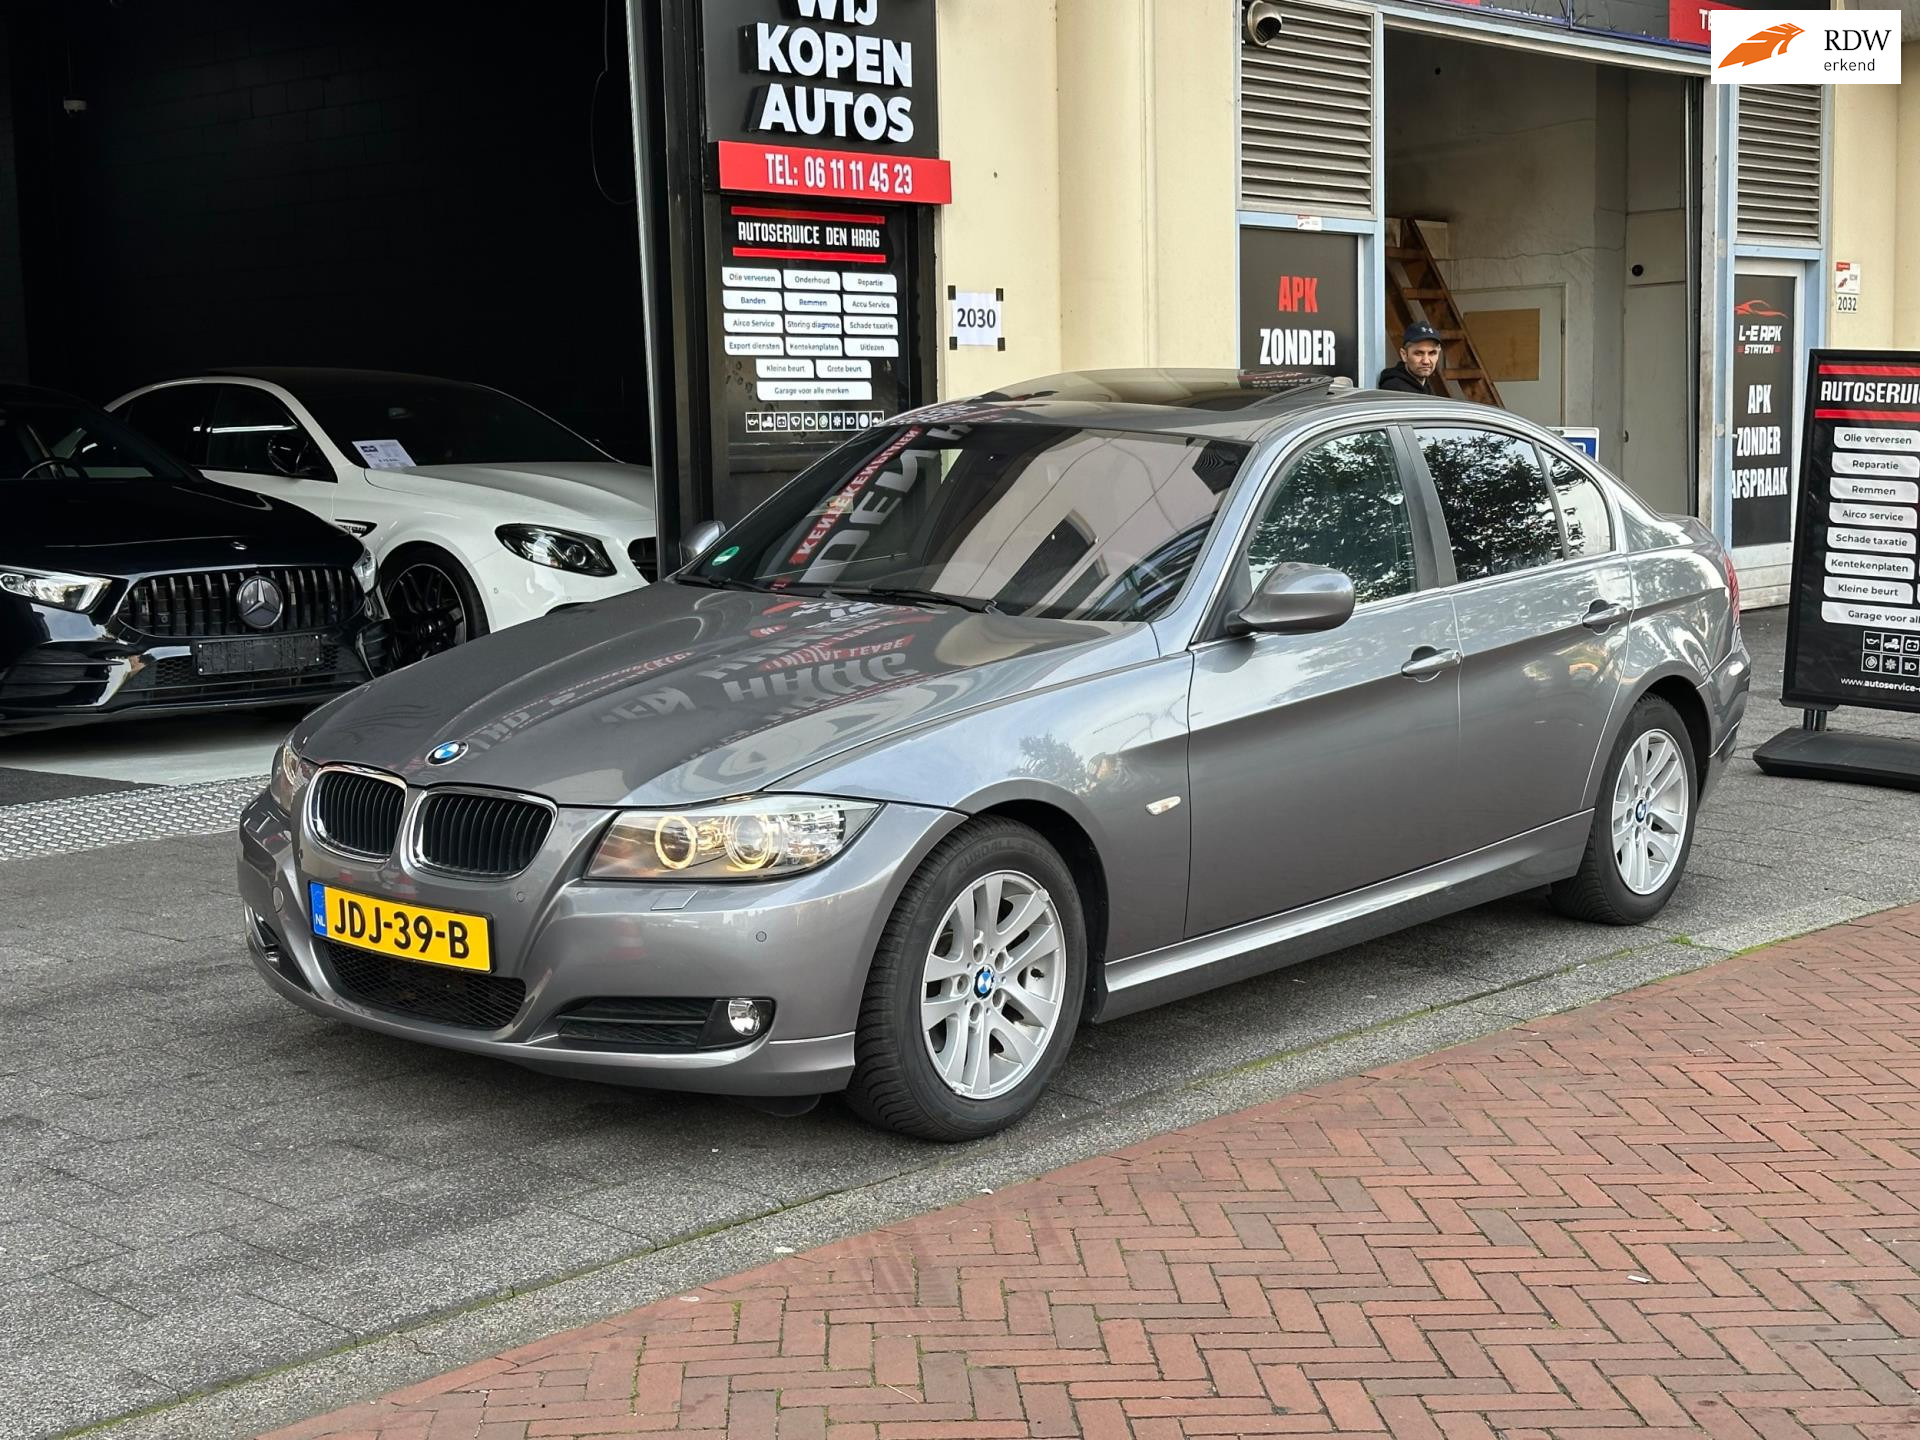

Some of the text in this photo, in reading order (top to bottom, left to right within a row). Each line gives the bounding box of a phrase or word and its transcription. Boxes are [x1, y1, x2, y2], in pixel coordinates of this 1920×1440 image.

[757, 22, 913, 88] KOPEN
[759, 83, 914, 142] AUTOS
[765, 153, 912, 194] TEL: 06 11 11 45 23
[738, 221, 880, 248] AUTOSERVICE DEN HAAG
[794, 276, 830, 284] Onderhoud
[740, 296, 766, 304] Banden
[1278, 276, 1318, 313] APK
[1838, 296, 1857, 311] 2032
[733, 319, 775, 327] Airco Service
[957, 308, 996, 328] 2030
[787, 320, 840, 330] Storing diagnose
[1738, 324, 1782, 342] L-E APK
[729, 342, 751, 350] Export
[789, 343, 839, 351] Kentekenplaten
[1259, 328, 1336, 366] ZONDER
[1744, 344, 1774, 355] STATION
[787, 364, 805, 372] beurt
[845, 365, 862, 373] beurt
[774, 387, 797, 395] Garage
[813, 386, 824, 394] alle
[1747, 384, 1772, 414] APK
[1736, 426, 1781, 457] ZONDER
[1843, 433, 1912, 445] Olie verversen
[1852, 460, 1899, 471] Reparatie
[1851, 485, 1896, 496] Remmen
[1842, 510, 1904, 522] Airco service
[1836, 533, 1908, 547] Schade taxatie
[1831, 559, 1909, 573] Kentekenplaten
[1838, 584, 1899, 597] Kleine beurt
[1848, 610, 1882, 622] Garage
[1885, 615, 1907, 623] voor
[1841, 678, 1920, 692] www.autoservice-
[315, 913, 326, 927] NL
[334, 898, 469, 959] JDJ-39-B
